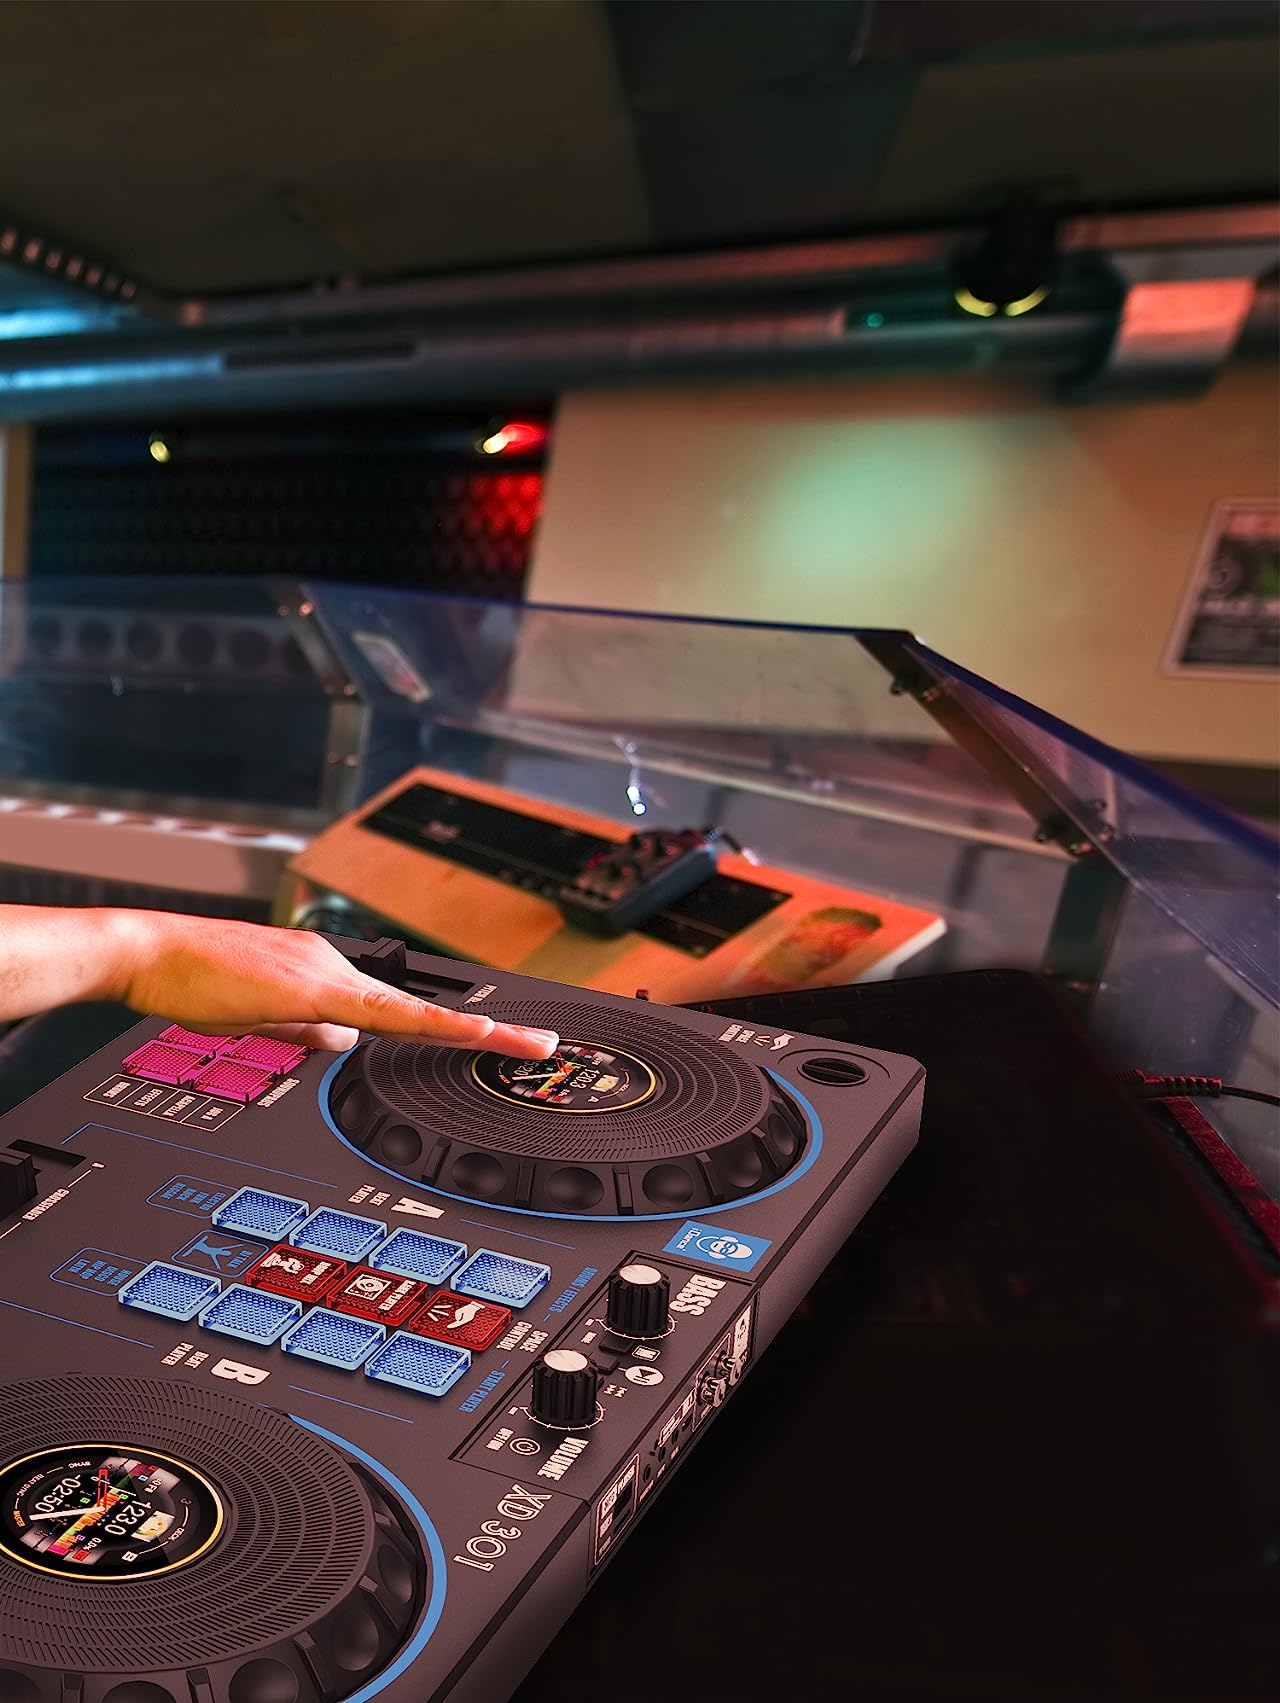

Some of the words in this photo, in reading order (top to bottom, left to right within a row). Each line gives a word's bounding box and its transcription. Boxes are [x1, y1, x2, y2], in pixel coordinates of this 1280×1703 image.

[256, 1077, 302, 1109] SOUNDPADS
[21, 1187, 70, 1221] CROSSFADER
[347, 1184, 377, 1204] PLAYER
[369, 1191, 391, 1206] BEAT
[390, 1197, 447, 1220] A
[549, 1288, 577, 1313] EFFECTS
[669, 1273, 728, 1316] BASS
[496, 1321, 533, 1352] CONTROL
[519, 1330, 550, 1353] SPACE
[160, 1342, 194, 1366] PLAYER
[184, 1351, 210, 1369] BEAT
[210, 1358, 271, 1385] B
[481, 1370, 507, 1393] START
[458, 1389, 488, 1414] PLAYER
[536, 1436, 590, 1482] VOLUME
[496, 1483, 553, 1521] XD
[104, 1500, 152, 1536] 123.0
[453, 1519, 522, 1573] 301
